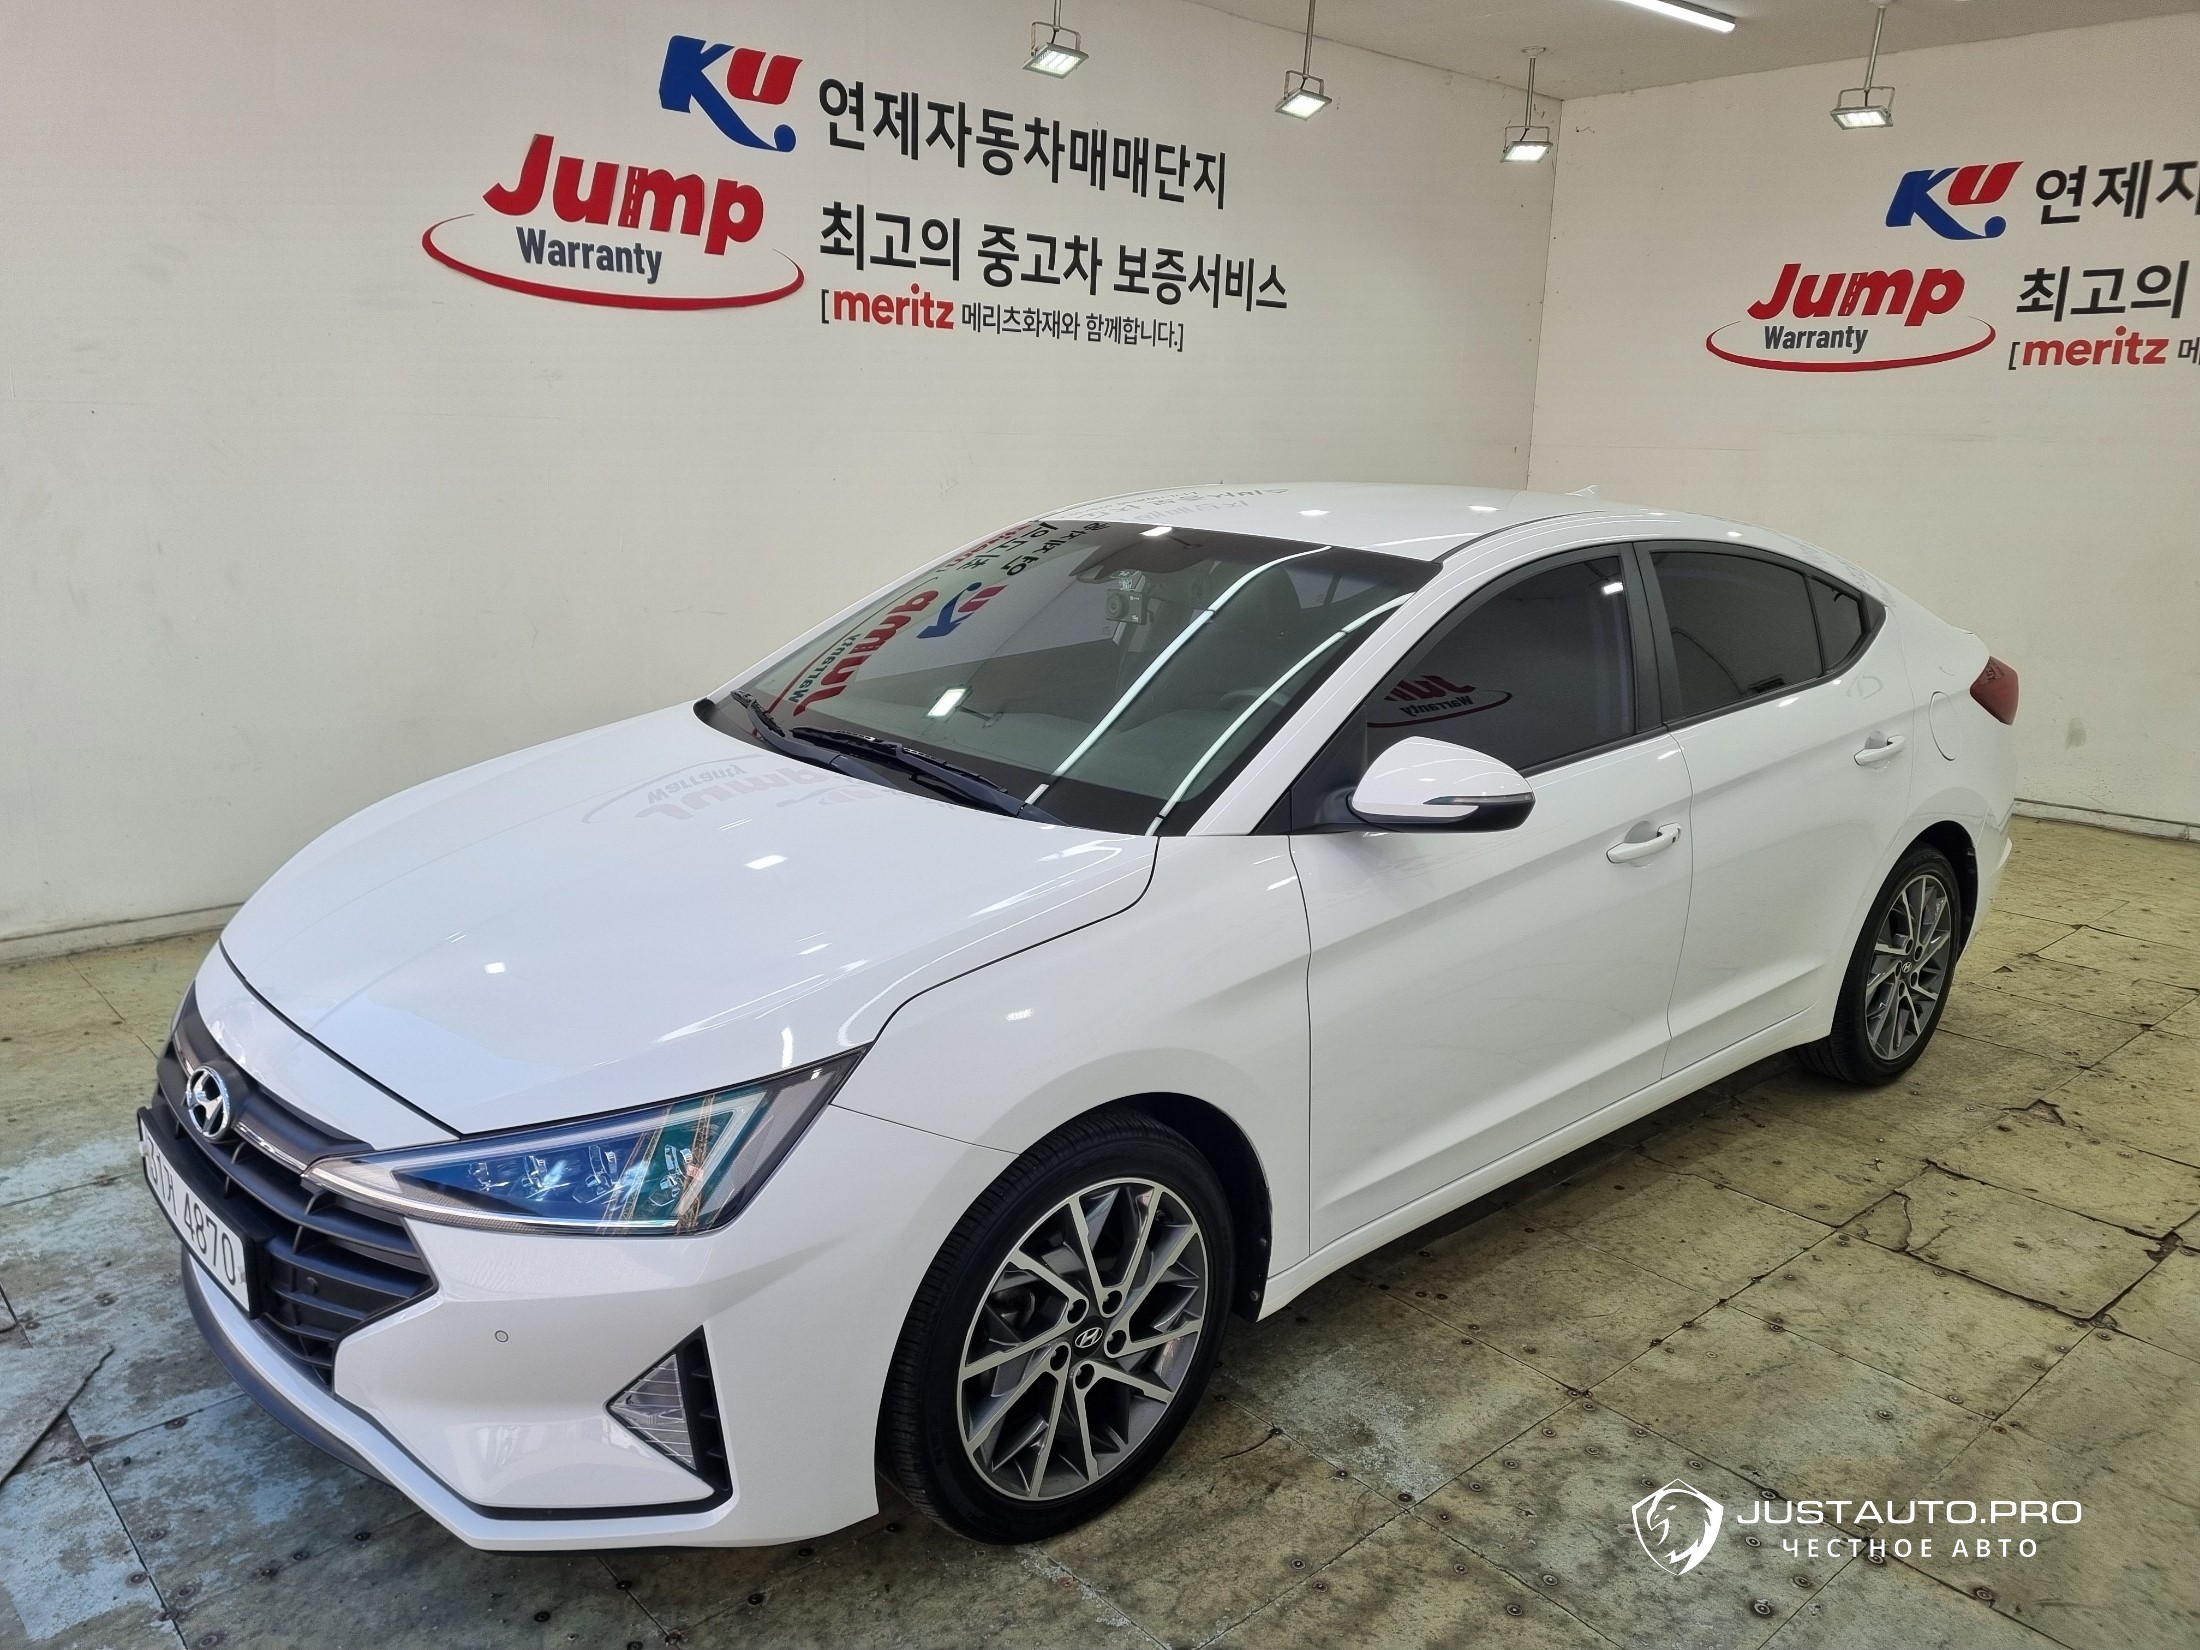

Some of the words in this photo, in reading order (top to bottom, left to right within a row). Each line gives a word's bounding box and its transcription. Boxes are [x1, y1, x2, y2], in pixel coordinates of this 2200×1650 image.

[819, 78, 1227, 210] 연제자동차매매단지
[483, 134, 765, 256] Jump
[515, 226, 662, 285] Warranty
[819, 200, 961, 281] 최고의
[977, 223, 1103, 296] 중고차
[1113, 244, 1288, 312] 보증서비스
[961, 302, 1081, 341] 메리츠화재와
[1746, 263, 1966, 327] Jump
[2015, 260, 2191, 323] 최고의
[1763, 325, 1869, 355] Warranty
[182, 1191, 237, 1287] 4870
